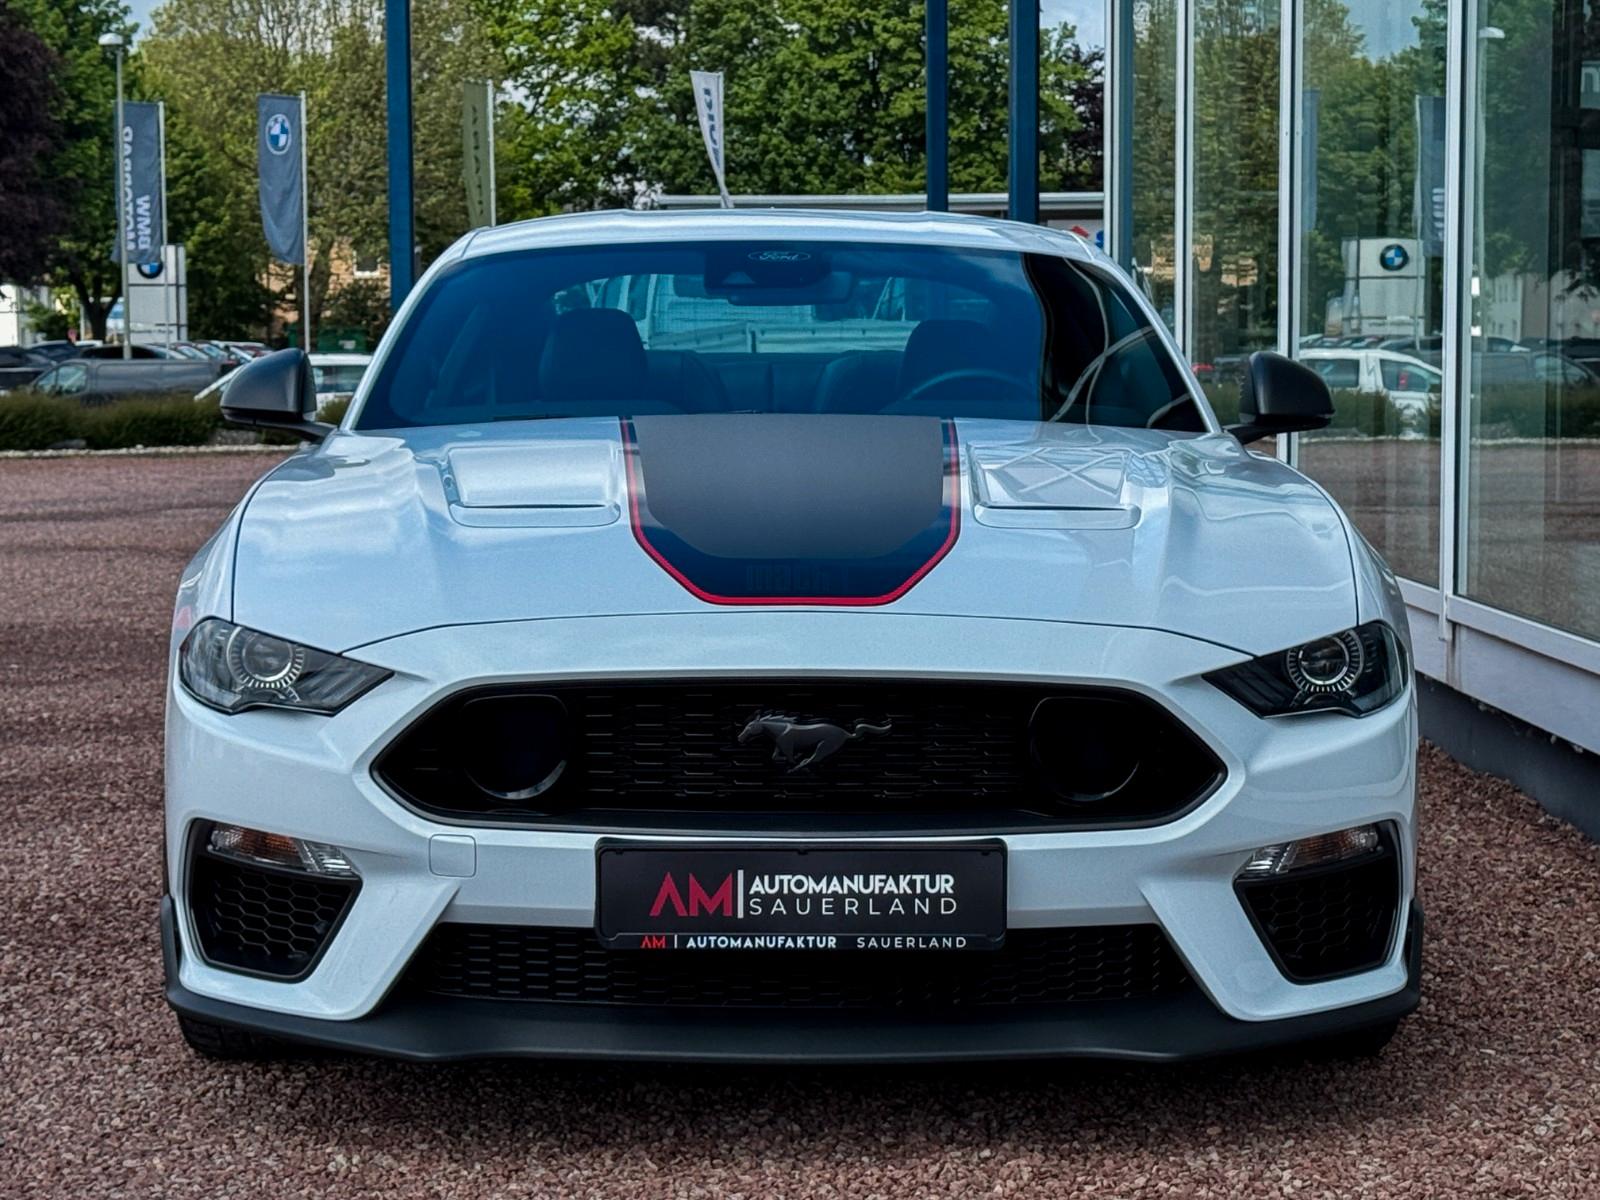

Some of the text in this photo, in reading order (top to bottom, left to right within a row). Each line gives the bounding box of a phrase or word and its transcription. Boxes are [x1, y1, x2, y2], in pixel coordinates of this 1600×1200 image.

[649, 871, 733, 916] AM
[749, 874, 955, 894] AUTOMANUFAKTUR
[749, 897, 957, 915] SAUERLAND
[641, 936, 967, 948] AM AUTOMANUFAKTUR SAUERLAND
